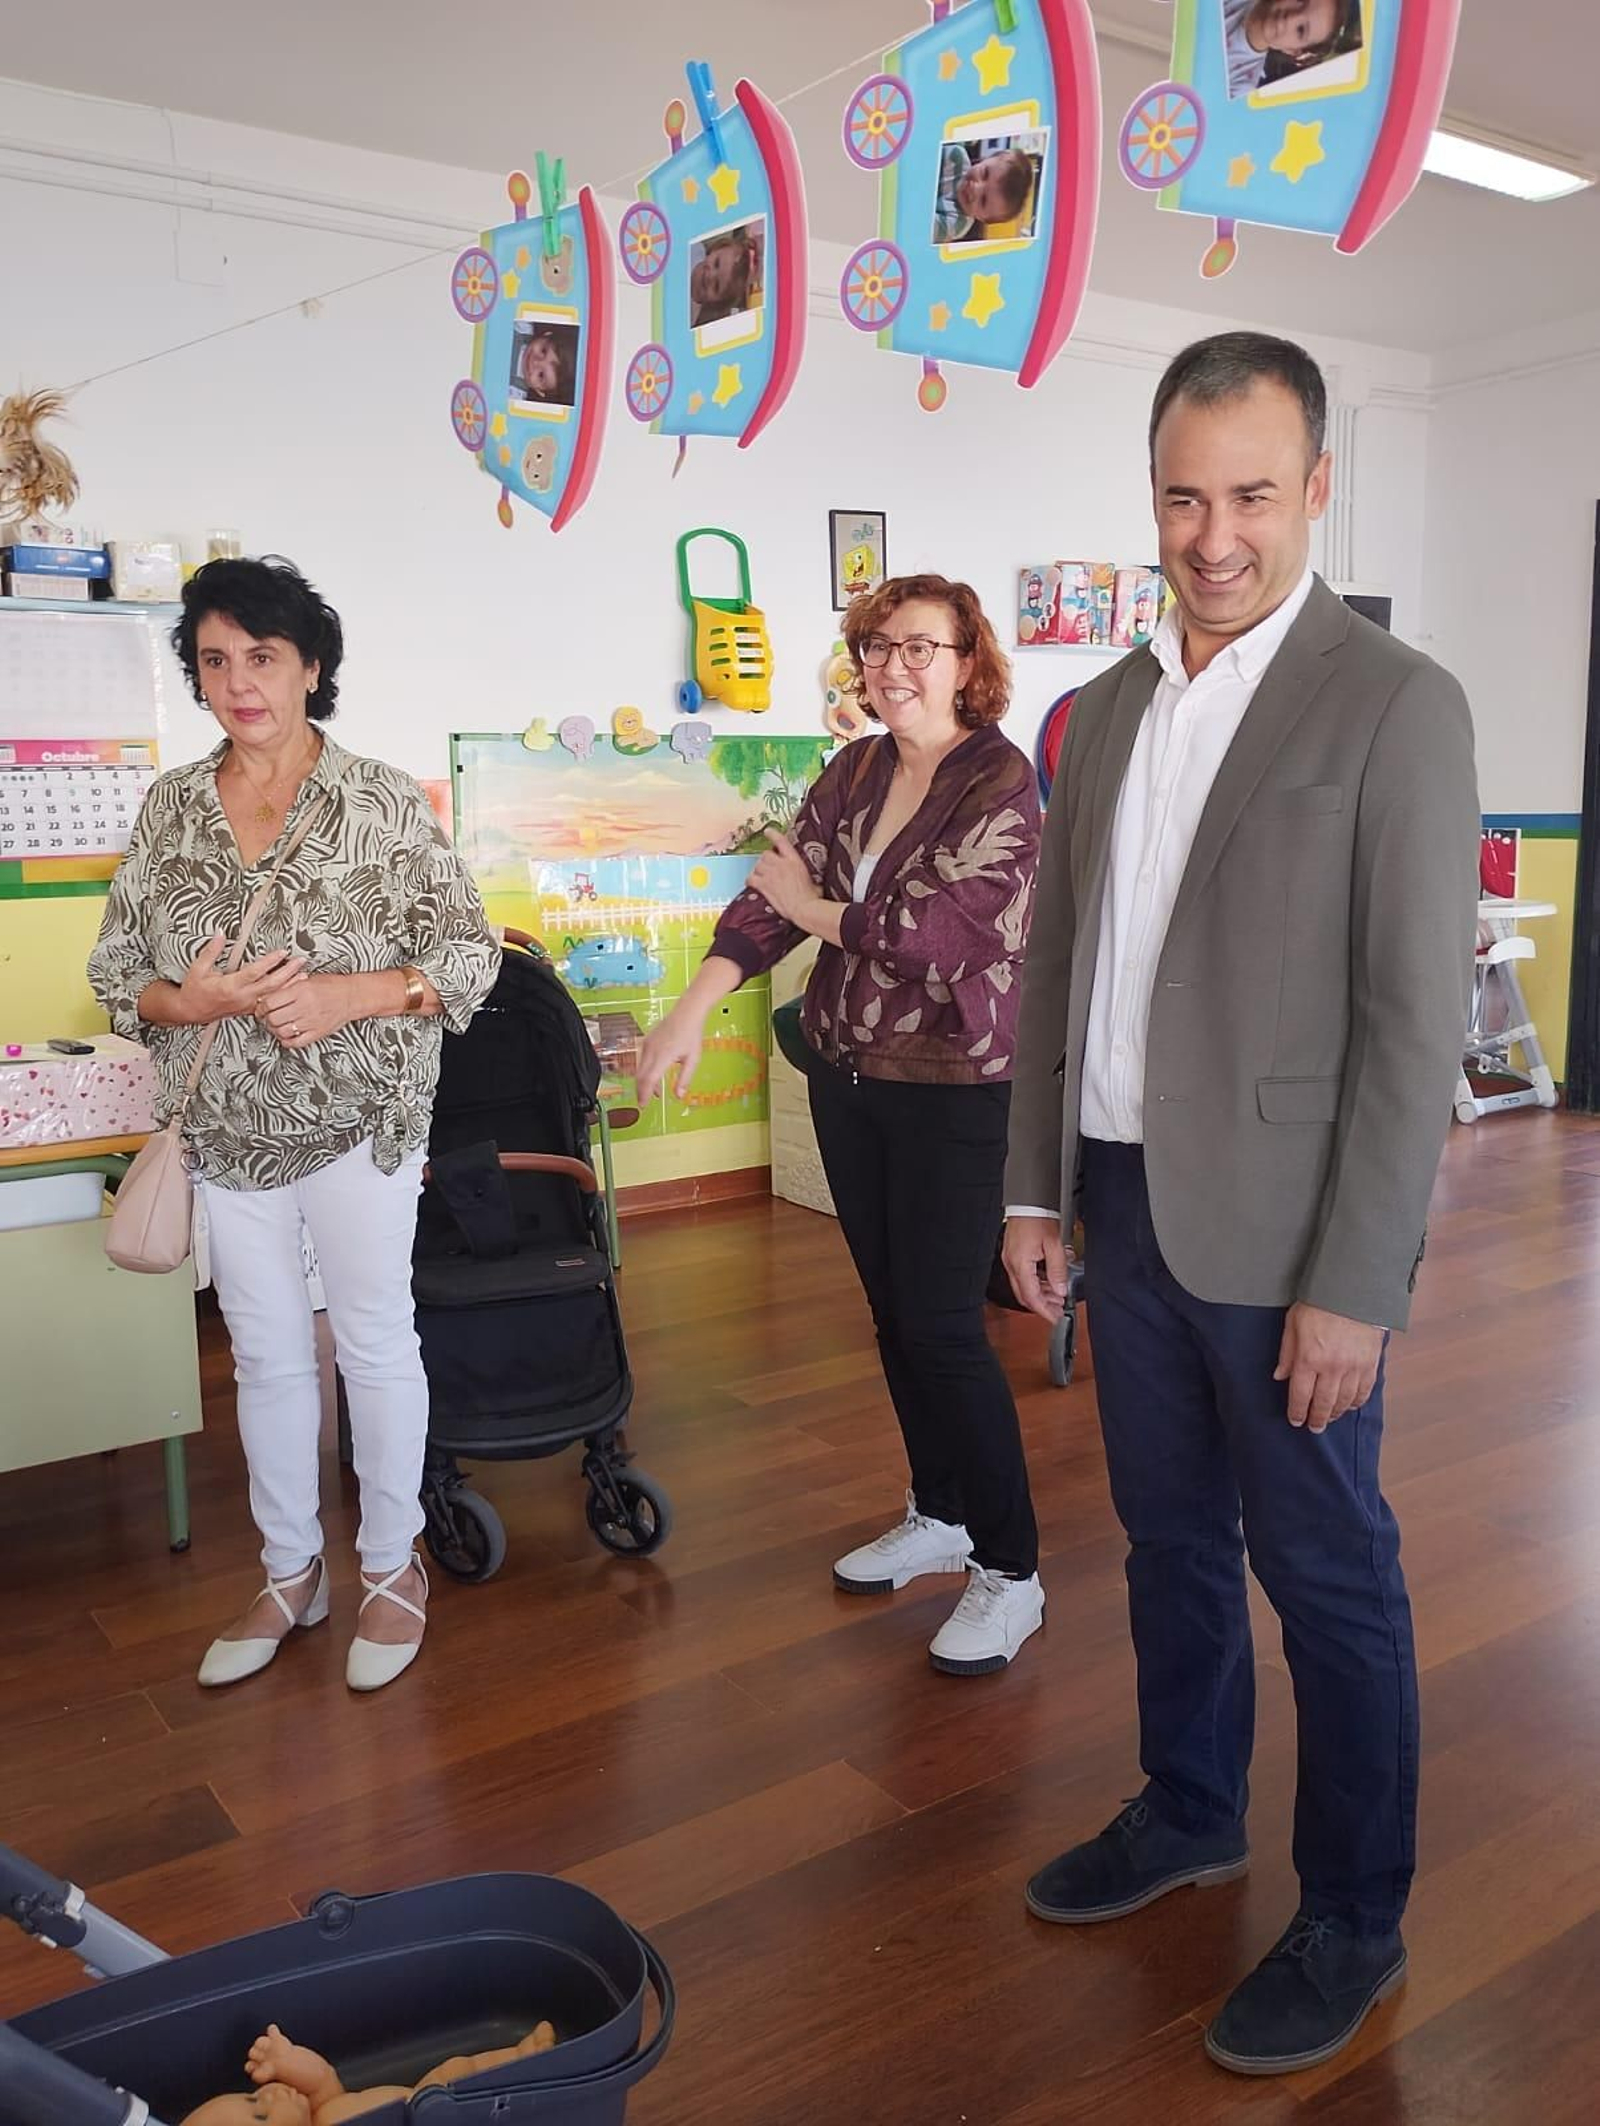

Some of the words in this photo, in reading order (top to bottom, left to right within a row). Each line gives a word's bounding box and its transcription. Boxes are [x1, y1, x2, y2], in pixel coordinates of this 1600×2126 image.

[42, 752, 100, 762] Octubre
[1, 823, 15, 831] 20
[49, 822, 60, 830] 22
[73, 821, 84, 829] 23
[117, 820, 128, 828] 25
[50, 838, 62, 847] 29
[74, 838, 87, 846] 30
